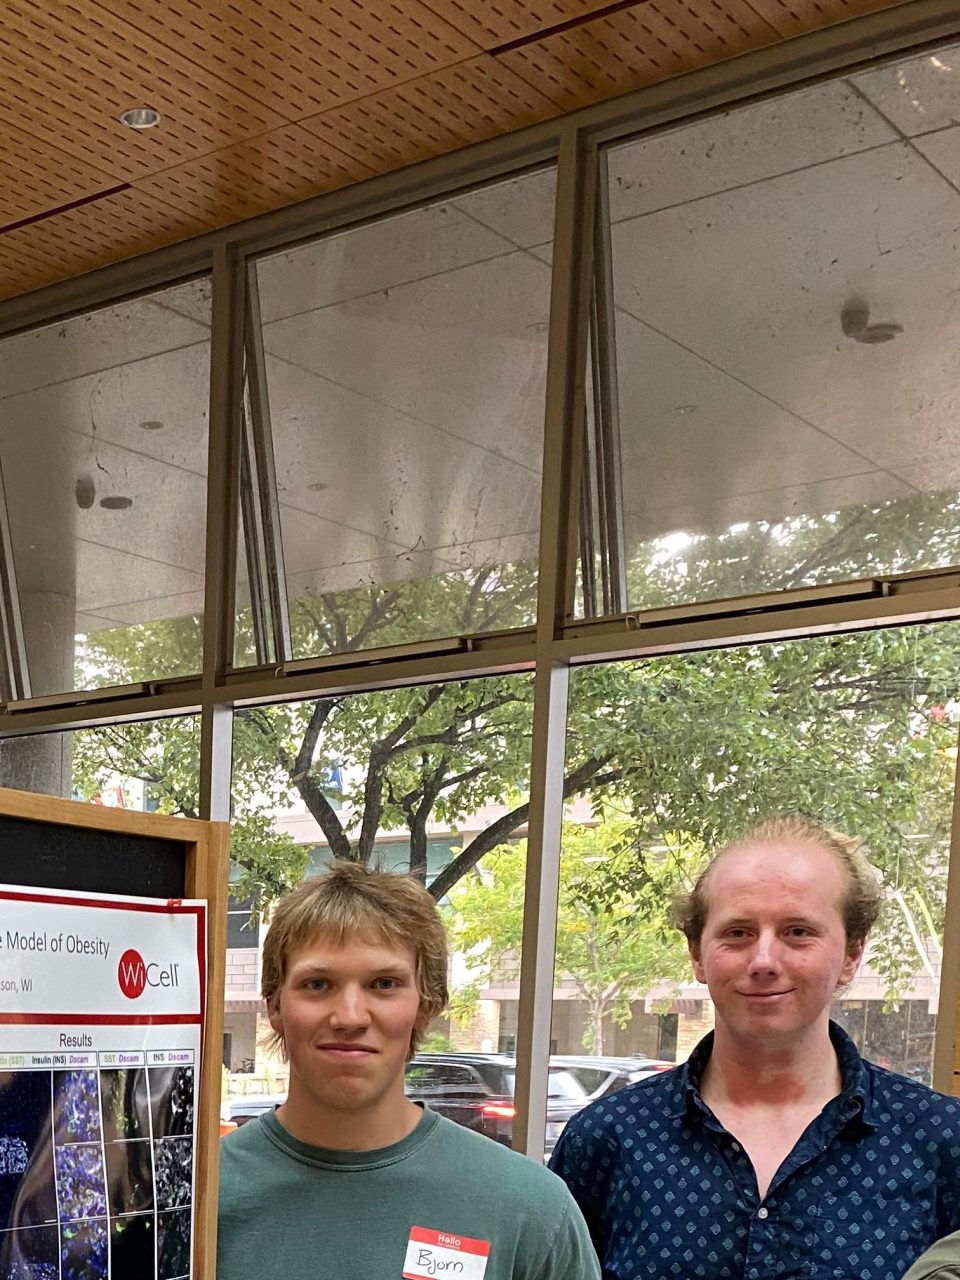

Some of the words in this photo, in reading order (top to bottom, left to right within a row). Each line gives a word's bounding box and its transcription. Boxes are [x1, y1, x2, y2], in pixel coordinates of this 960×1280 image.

[7, 930, 47, 952] Model
[50, 933, 63, 952] of
[66, 935, 110, 960] Obesity
[121, 960, 178, 989] WiCell
[21, 978, 32, 992] WI
[59, 1033, 92, 1047] Results
[32, 1055, 51, 1064] Insulin
[52, 1055, 66, 1065] (INS)
[69, 1055, 88, 1064] Dscam
[118, 1054, 139, 1062] Dscam
[168, 1052, 189, 1061] Dscam
[438, 1234, 461, 1246] Hello
[416, 1249, 464, 1275] Bjorn
